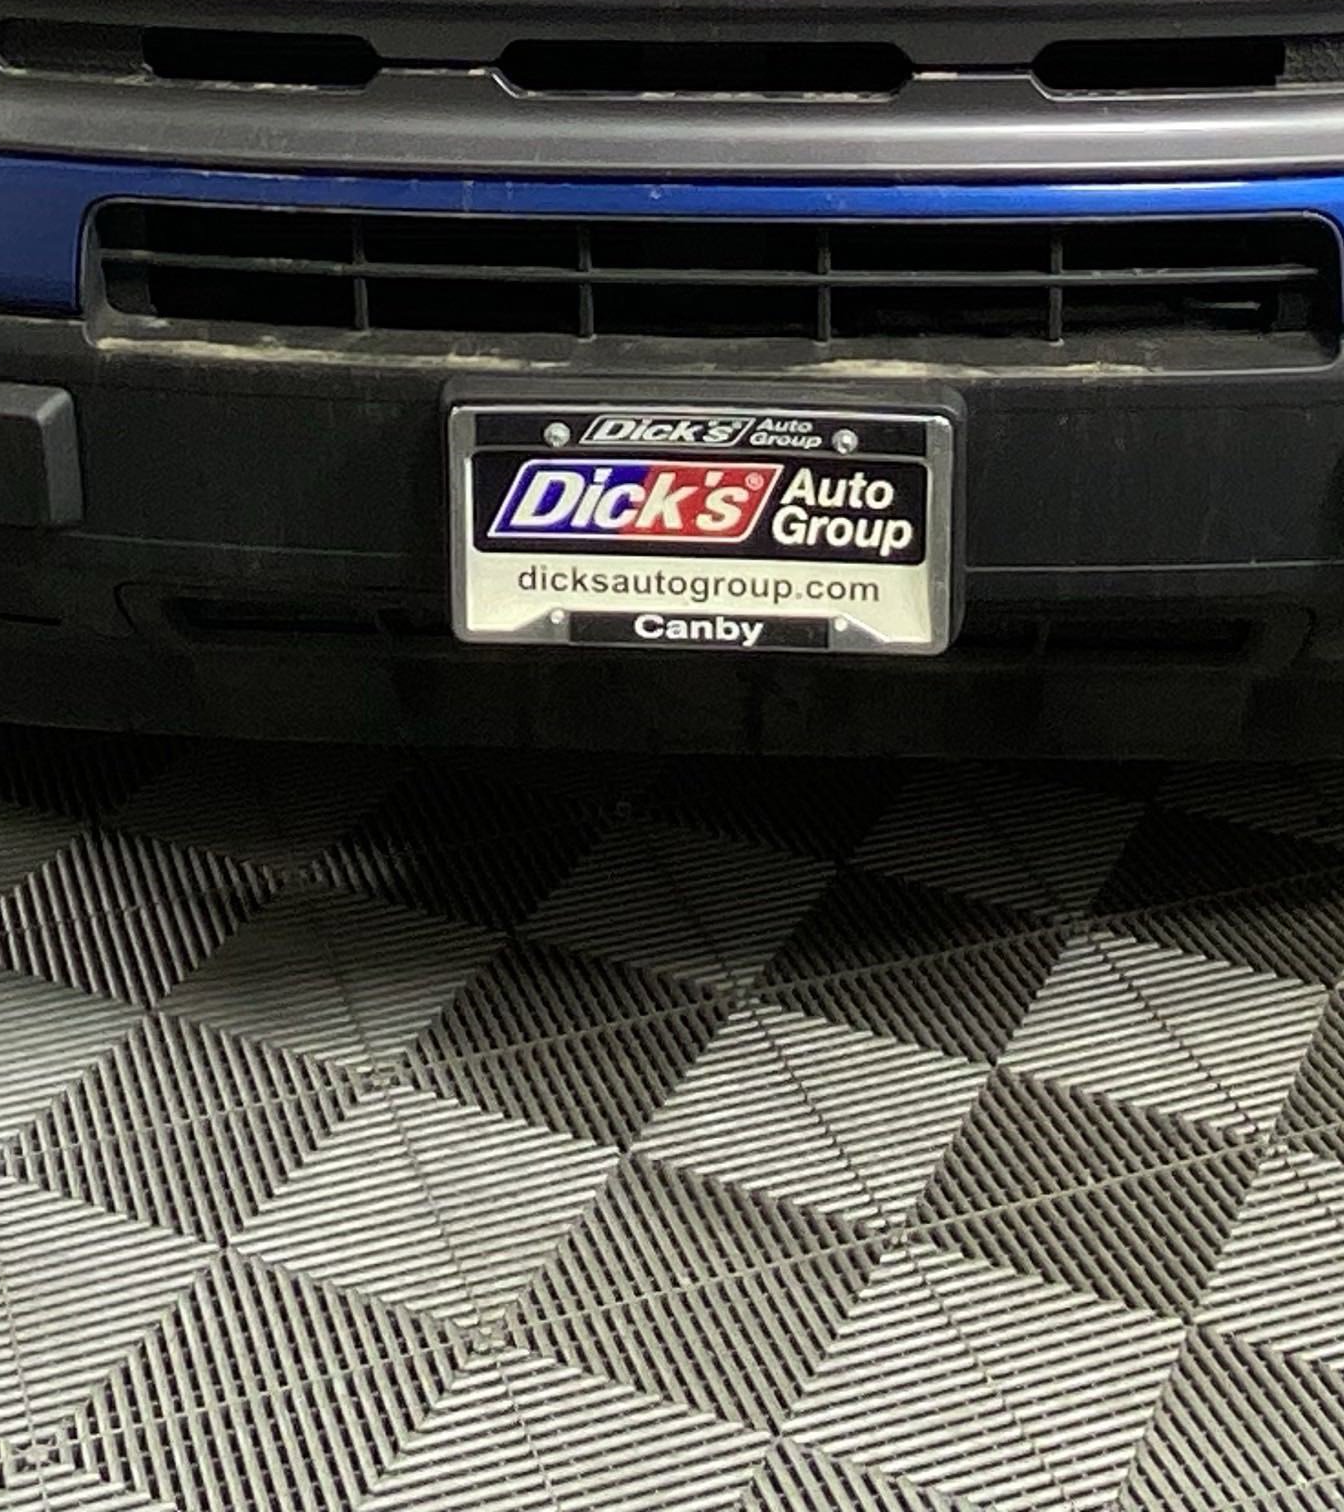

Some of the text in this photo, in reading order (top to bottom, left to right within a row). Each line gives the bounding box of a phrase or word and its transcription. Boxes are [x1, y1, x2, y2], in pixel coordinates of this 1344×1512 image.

[593, 418, 738, 443] Dick's
[749, 432, 822, 450] Group
[755, 418, 813, 434] Auto
[510, 467, 749, 531] Dick's
[781, 467, 894, 508] Auto
[772, 505, 913, 556] Group
[518, 566, 881, 603] dicksautogroup.com
[633, 614, 765, 646] Canby
